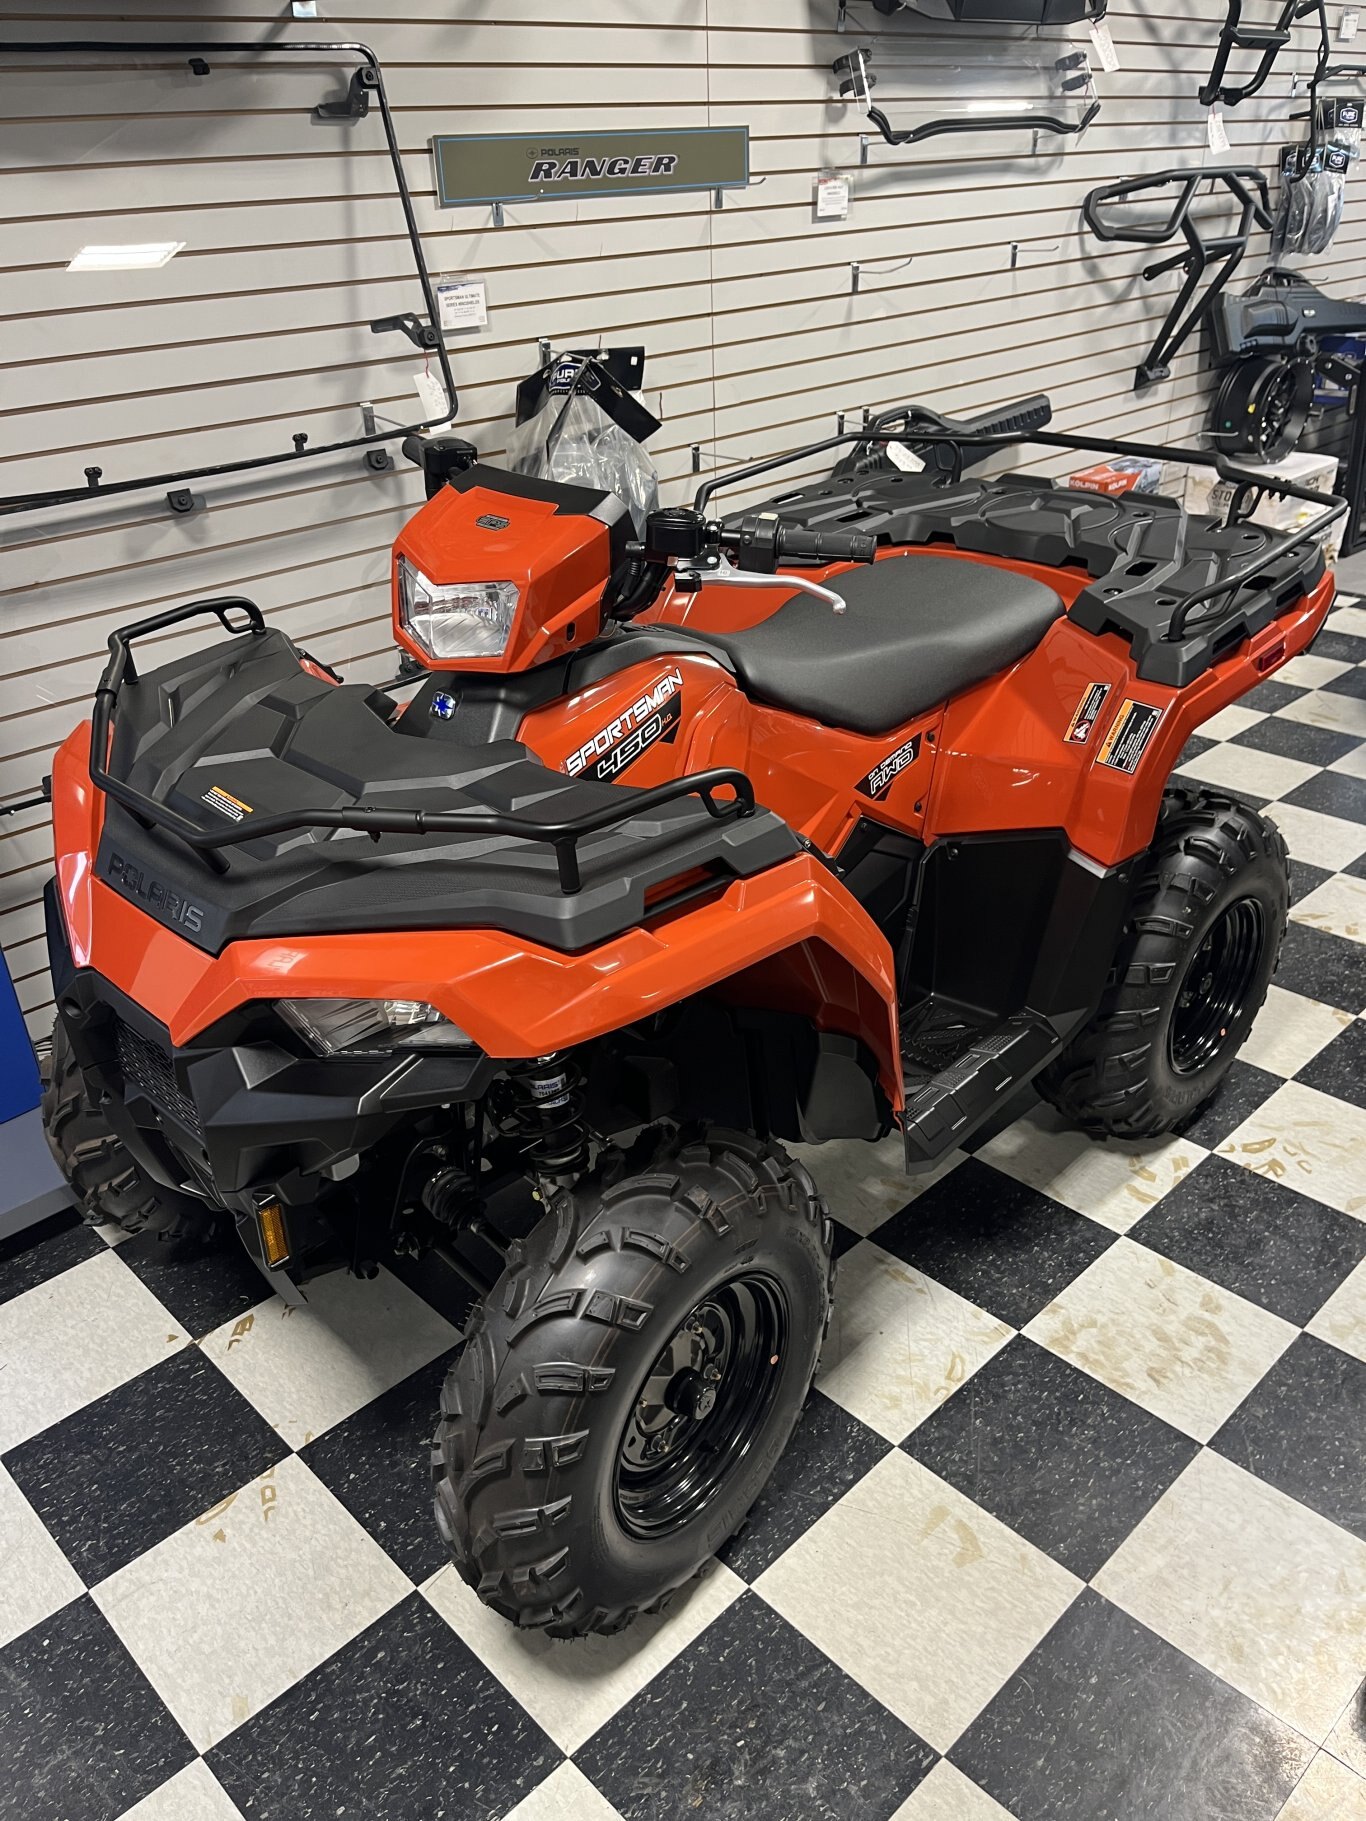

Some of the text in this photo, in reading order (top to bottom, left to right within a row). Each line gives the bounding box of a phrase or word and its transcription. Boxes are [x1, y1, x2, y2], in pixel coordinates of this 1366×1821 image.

[528, 154, 678, 182] RANGER
[541, 148, 580, 156] POLARIS
[1070, 480, 1099, 490] KOLPIN
[566, 667, 683, 777] SPORTSMAN
[1109, 714, 1125, 740] WARNING
[597, 714, 662, 778] 450
[870, 748, 914, 795] AWD
[107, 853, 204, 932] POLARIS
